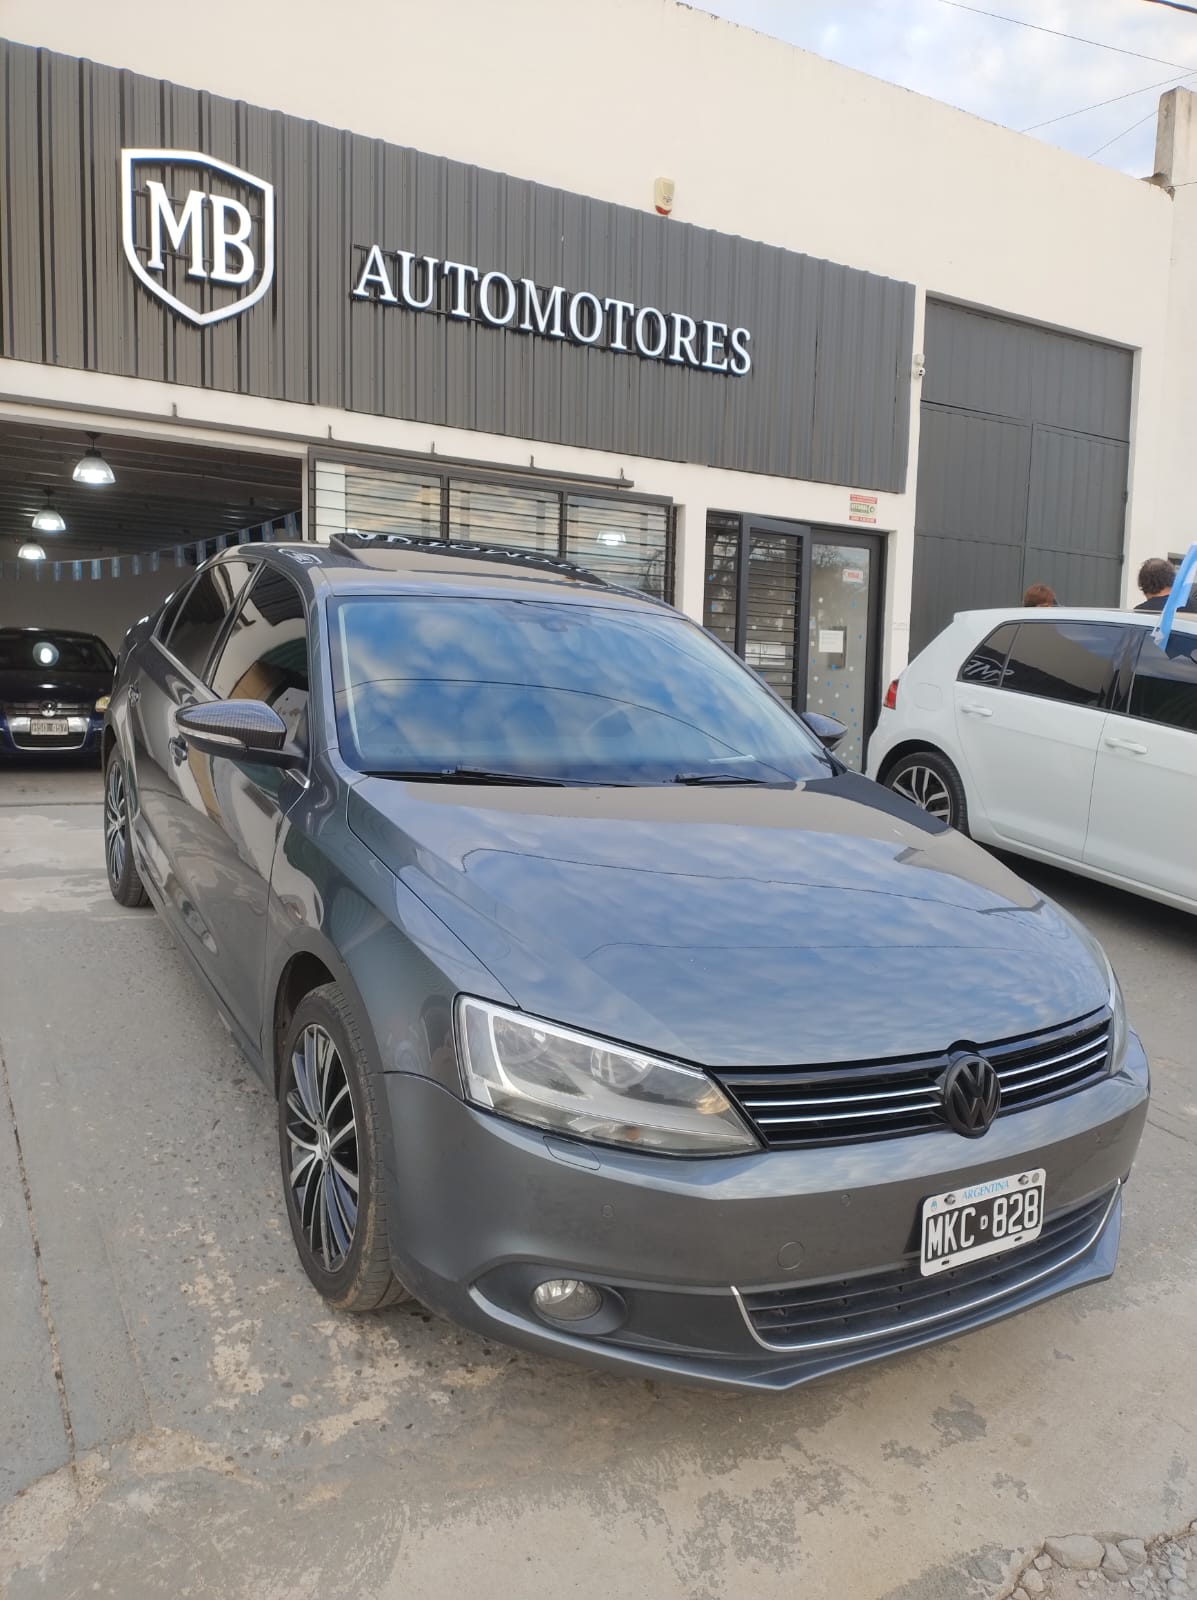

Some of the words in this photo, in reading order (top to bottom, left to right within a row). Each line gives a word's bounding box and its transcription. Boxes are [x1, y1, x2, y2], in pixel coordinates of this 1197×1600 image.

[146, 180, 255, 284] MB
[353, 244, 752, 376] AUTOMOTORES
[927, 1207, 976, 1260] MKC
[992, 1188, 1039, 1238] 828
[962, 1180, 1009, 1201] ARGENTINA
